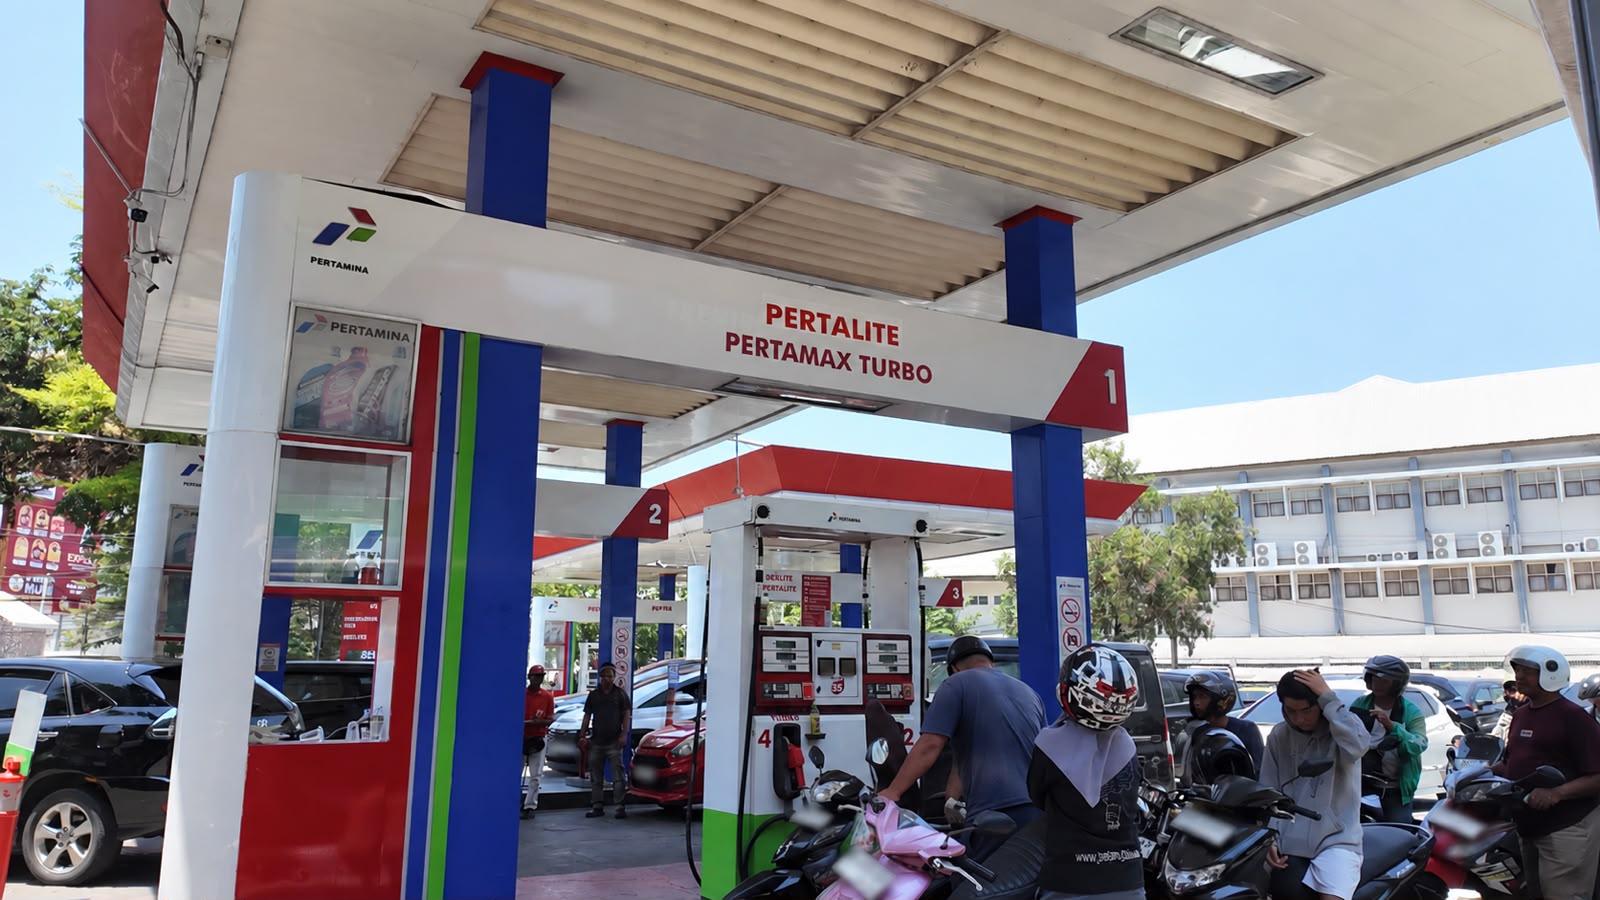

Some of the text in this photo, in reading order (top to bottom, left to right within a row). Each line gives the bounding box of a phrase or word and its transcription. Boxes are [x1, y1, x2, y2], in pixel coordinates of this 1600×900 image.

[310, 256, 369, 274] PERTAMINA
[330, 322, 411, 342] PERTAMINA
[766, 303, 899, 346] PERTALITE
[725, 332, 933, 385] PERTAMAX TURBO
[1103, 369, 1117, 404] 1
[649, 503, 662, 524] 2
[952, 587, 960, 599] 3
[758, 729, 771, 748] 4
[904, 728, 914, 746] 2
